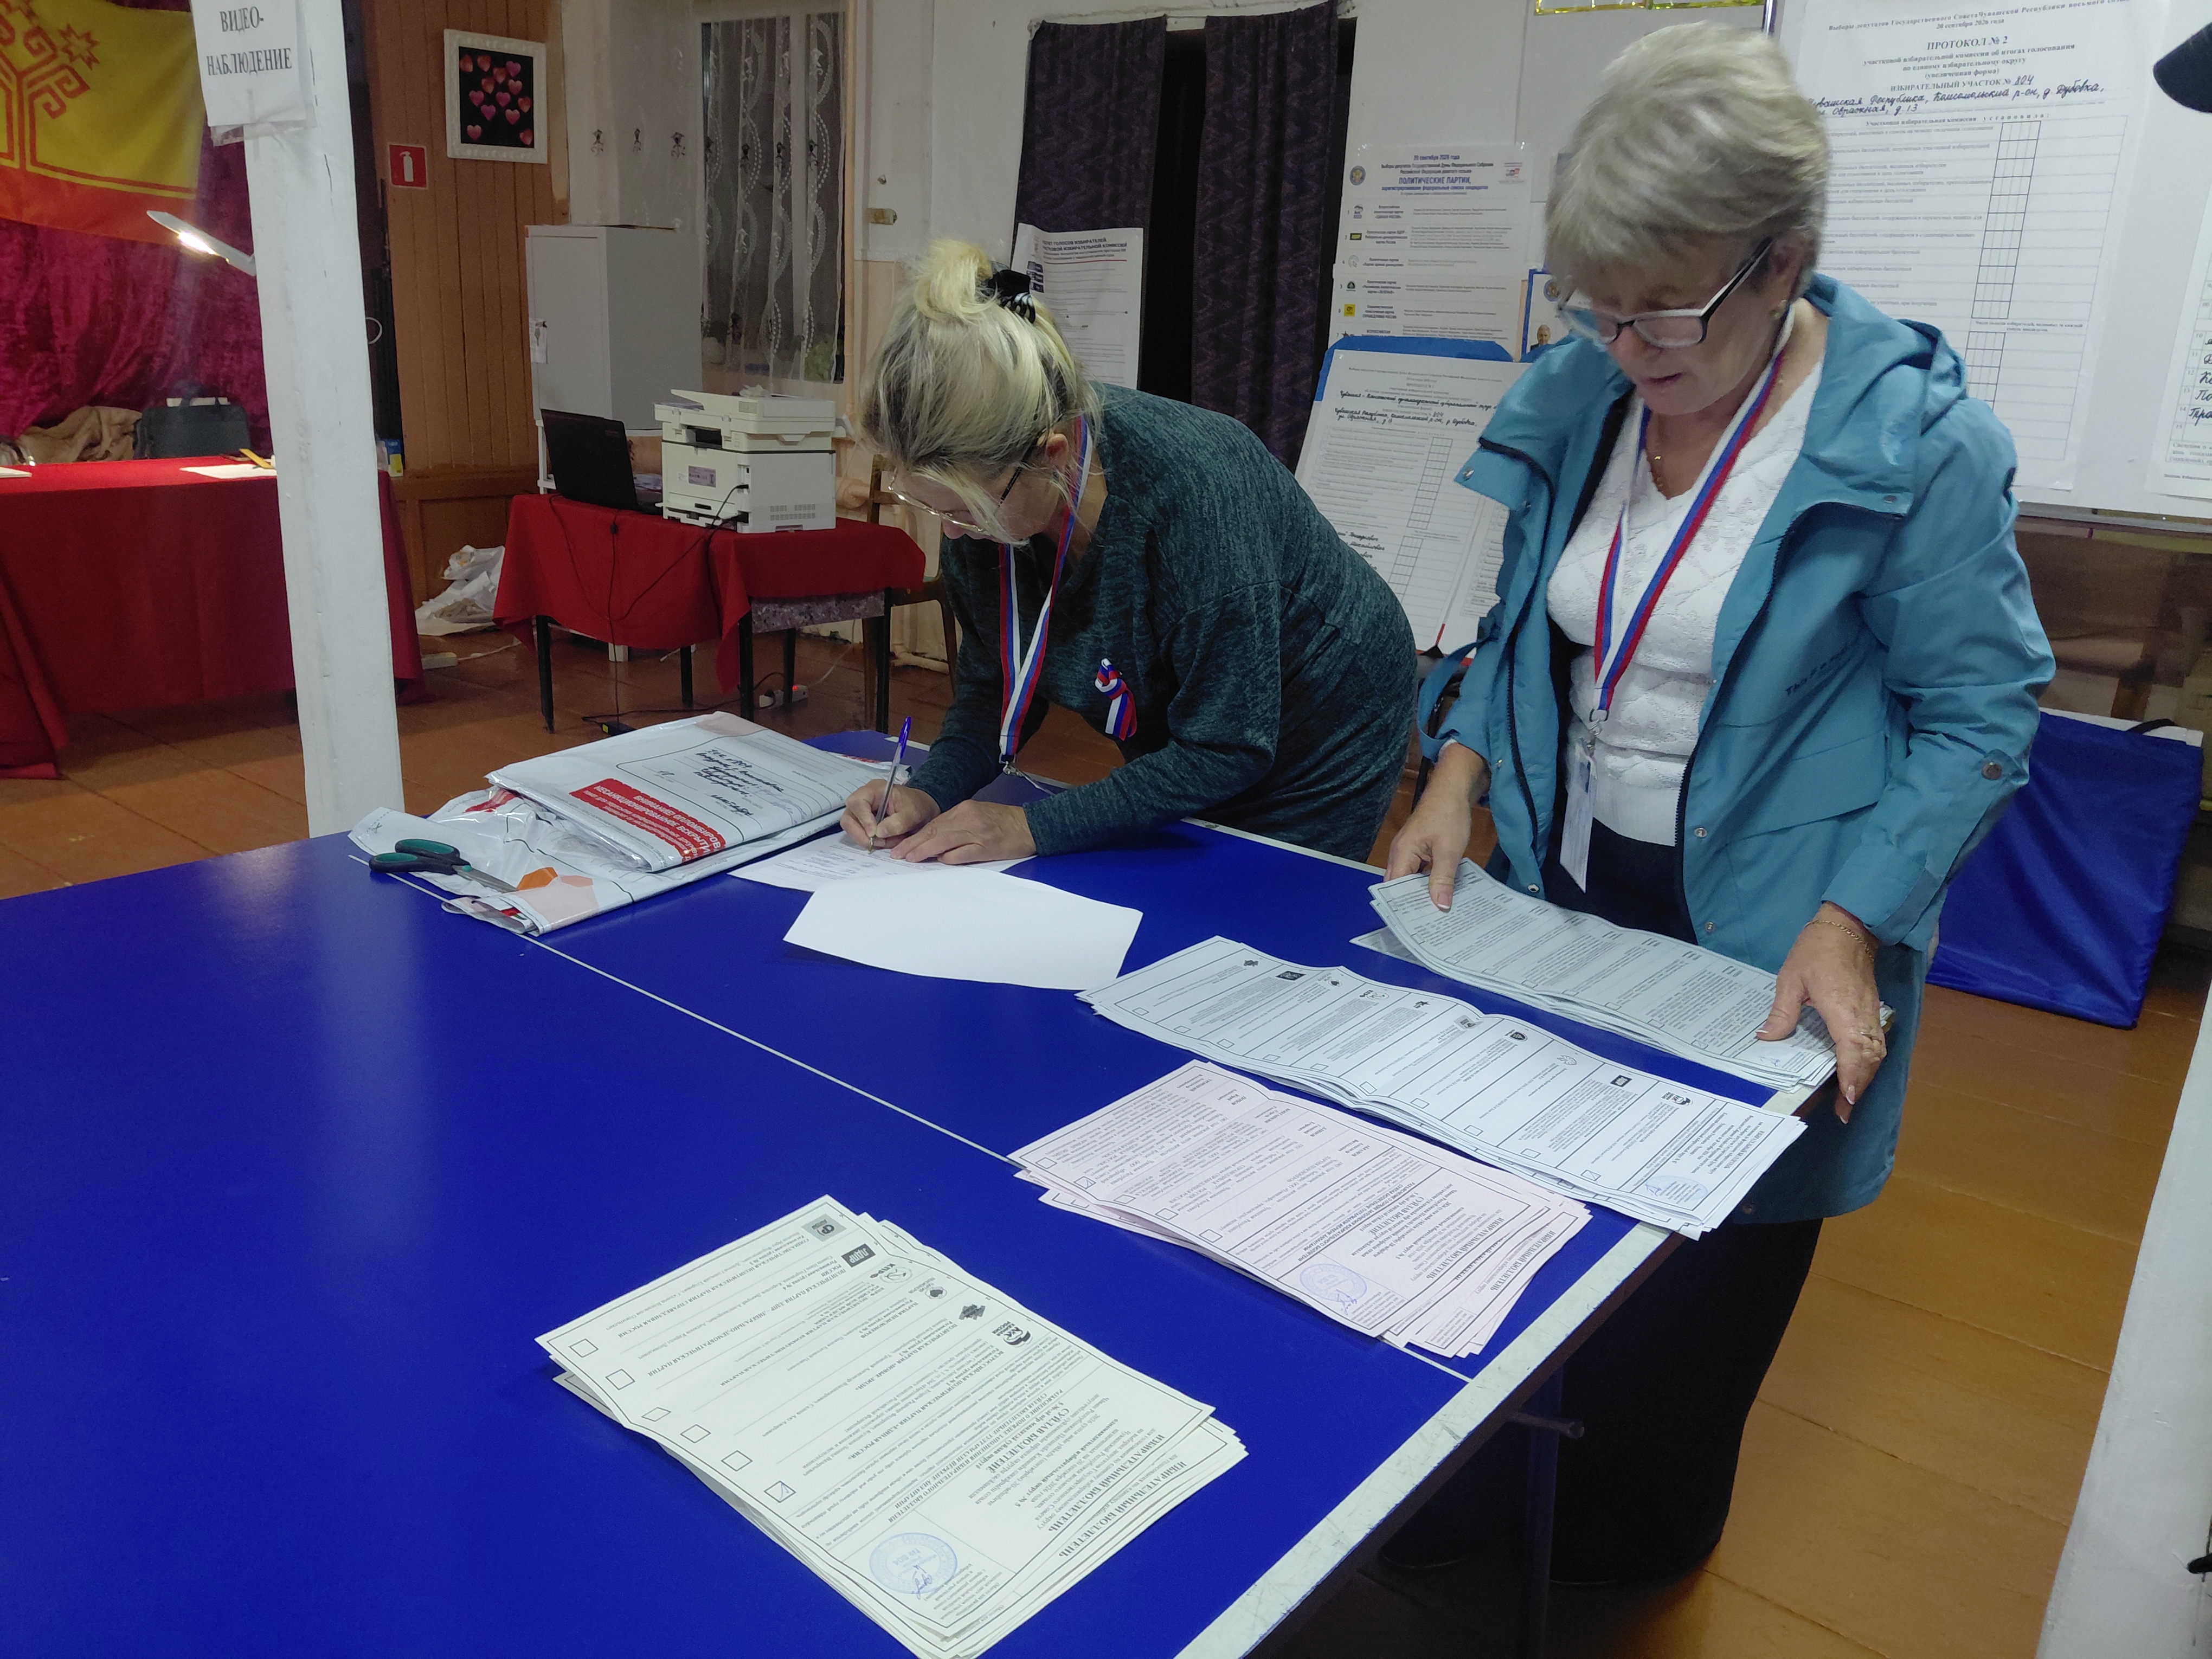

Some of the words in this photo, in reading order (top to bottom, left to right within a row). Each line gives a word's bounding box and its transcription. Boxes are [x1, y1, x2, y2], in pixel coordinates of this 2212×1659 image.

[220, 6, 264, 34] ВИДЕО-
[1891, 16, 1951, 26] Государственного
[2021, 3, 2065, 14] Республики
[1927, 37, 1986, 50] ПРОТОКОЛ
[1988, 37, 2000, 46] №
[2002, 35, 2008, 44] 2
[207, 48, 292, 76] НАБЛЮДЕНИЕ
[1863, 56, 1901, 66] участковой
[1903, 54, 1953, 63] избирательной
[2027, 44, 2075, 54] голосования
[1943, 60, 1999, 69] избирательному
[1973, 68, 1999, 77] форма)
[2014, 74, 2034, 86] 804
[1891, 80, 1959, 92] ИЗБИРАТЕЛЬНЫЙ
[1962, 79, 2001, 87] УЧАСТОК
[594, 786, 680, 827] НЕСАНКЦИОНИРОВАННОЕ
[1387, 1184, 1404, 1194] СУЙЛАВ
[1371, 1199, 1390, 1211] ПОРЯДКЕ
[1399, 1195, 1425, 1213] СУЙЛАВ
[1349, 1208, 1375, 1225] ЗАПОЛНЕНИЯ
[1320, 1223, 1353, 1245] ИЗБИРАТЕЛЬНОГО
[1457, 1217, 1505, 1252] ИЗБИРАТЕЛЬНЫЙ
[753, 1237, 811, 1268] СОЦИАЛИСТИЧЕСКАЯ
[844, 1247, 873, 1263] ЛДПР
[1296, 1243, 1324, 1262] БЮЛЛЕТЕНЯ
[1517, 1229, 1557, 1263] ИЗБИРАТЕЛЬНЫЙ
[806, 1259, 838, 1277] Региональная
[819, 1263, 843, 1277] РОССИИ
[867, 1262, 897, 1279] КПРФ
[1423, 1250, 1464, 1280] БЮЛЛЕТЕНЬ
[709, 1265, 756, 1291] ПОЛИТИЧЕСКАЯ
[790, 1274, 809, 1285] группа
[803, 1268, 847, 1293] ПОЛИТИЧЕСКАЯ
[1487, 1261, 1523, 1291] БЮЛЛЕТЕНЬ
[686, 1288, 712, 1303] ПАРТИЯ
[783, 1290, 807, 1304] ПАРТИЯ
[641, 1300, 690, 1326] СПРАВЕДЛИВАЯ
[768, 1301, 786, 1311] ЛДПР
[896, 1302, 919, 1315] ПАРТИЯ
[616, 1323, 644, 1338] РОССИЯ
[804, 1321, 828, 1335] ПАРТИЯ
[859, 1314, 899, 1339] ПЕНСИОНЕРОВ
[991, 1321, 1011, 1334] РОССИЯ
[994, 1323, 1015, 1336] ЕДИНАЯ
[671, 1309, 769, 1365] ЛИБЕРАЛЬНО-ДЕМОКРАТИЧЕСКАЯ
[915, 1323, 959, 1351] ПОЛИТИЧЕСКАЯ
[742, 1334, 807, 1372] КОММУНИСТИЧЕСКАЯ
[894, 1349, 919, 1365] ПАРТИЯ
[646, 1360, 674, 1377] ПАРТИЯ
[873, 1362, 898, 1378] «НОВЫЕ
[959, 1351, 1006, 1381] ВСЕРОССИЙСКАЯ
[718, 1371, 745, 1386] ПАРТИЯ
[853, 1376, 877, 1391] ЛЮДИ»
[918, 1379, 964, 1410] ПОЛИТИЧЕСКАЯ
[1025, 1393, 1049, 1409] СУЙЛАВ
[1027, 1388, 1066, 1416] РАЗЪЯСНЕНИЕ
[897, 1409, 923, 1425] ПАРТИЯ
[1000, 1417, 1028, 1436] ПОРЯДКЕ
[1033, 1407, 1072, 1435] СУЙЛАВ
[1085, 1413, 1101, 1424] 2026
[872, 1423, 901, 1443] «ЕДИНАЯ
[1076, 1418, 1121, 1451] одномандатный
[1101, 1429, 1132, 1452] Чувашской
[846, 1441, 876, 1461] РОССИЯ»
[968, 1434, 1005, 1461] ЗАПОЛНЕНИЯ
[1038, 1449, 1083, 1483] избирательный
[1073, 1450, 1106, 1475] Республики
[1096, 1433, 1167, 1489] ИЗБИРАТЕЛЬНЫЙ
[919, 1458, 973, 1496] ИЗБИРАТЕЛЬНОГО
[1052, 1463, 1079, 1482] сентября
[1022, 1481, 1044, 1496] округ
[1041, 1481, 1057, 1493] 2026
[1049, 1467, 1099, 1505] Государственного
[1113, 1458, 1187, 1516] ИЗБИРАТЕЛЬНЫЙ
[1017, 1495, 1028, 1503] №
[1028, 1490, 1045, 1503] года
[1051, 1478, 1098, 1514] избирательному
[885, 1494, 926, 1523] БЮЛЛЕТЕНЯ
[1033, 1503, 1056, 1521] Совета
[1043, 1485, 1104, 1533] БЮЛЛЕТЕНЬ
[1034, 1512, 1058, 1530] округу
[1056, 1511, 1118, 1560] БЮЛЛЕТЕНЬ
[891, 1553, 910, 1567] 804
